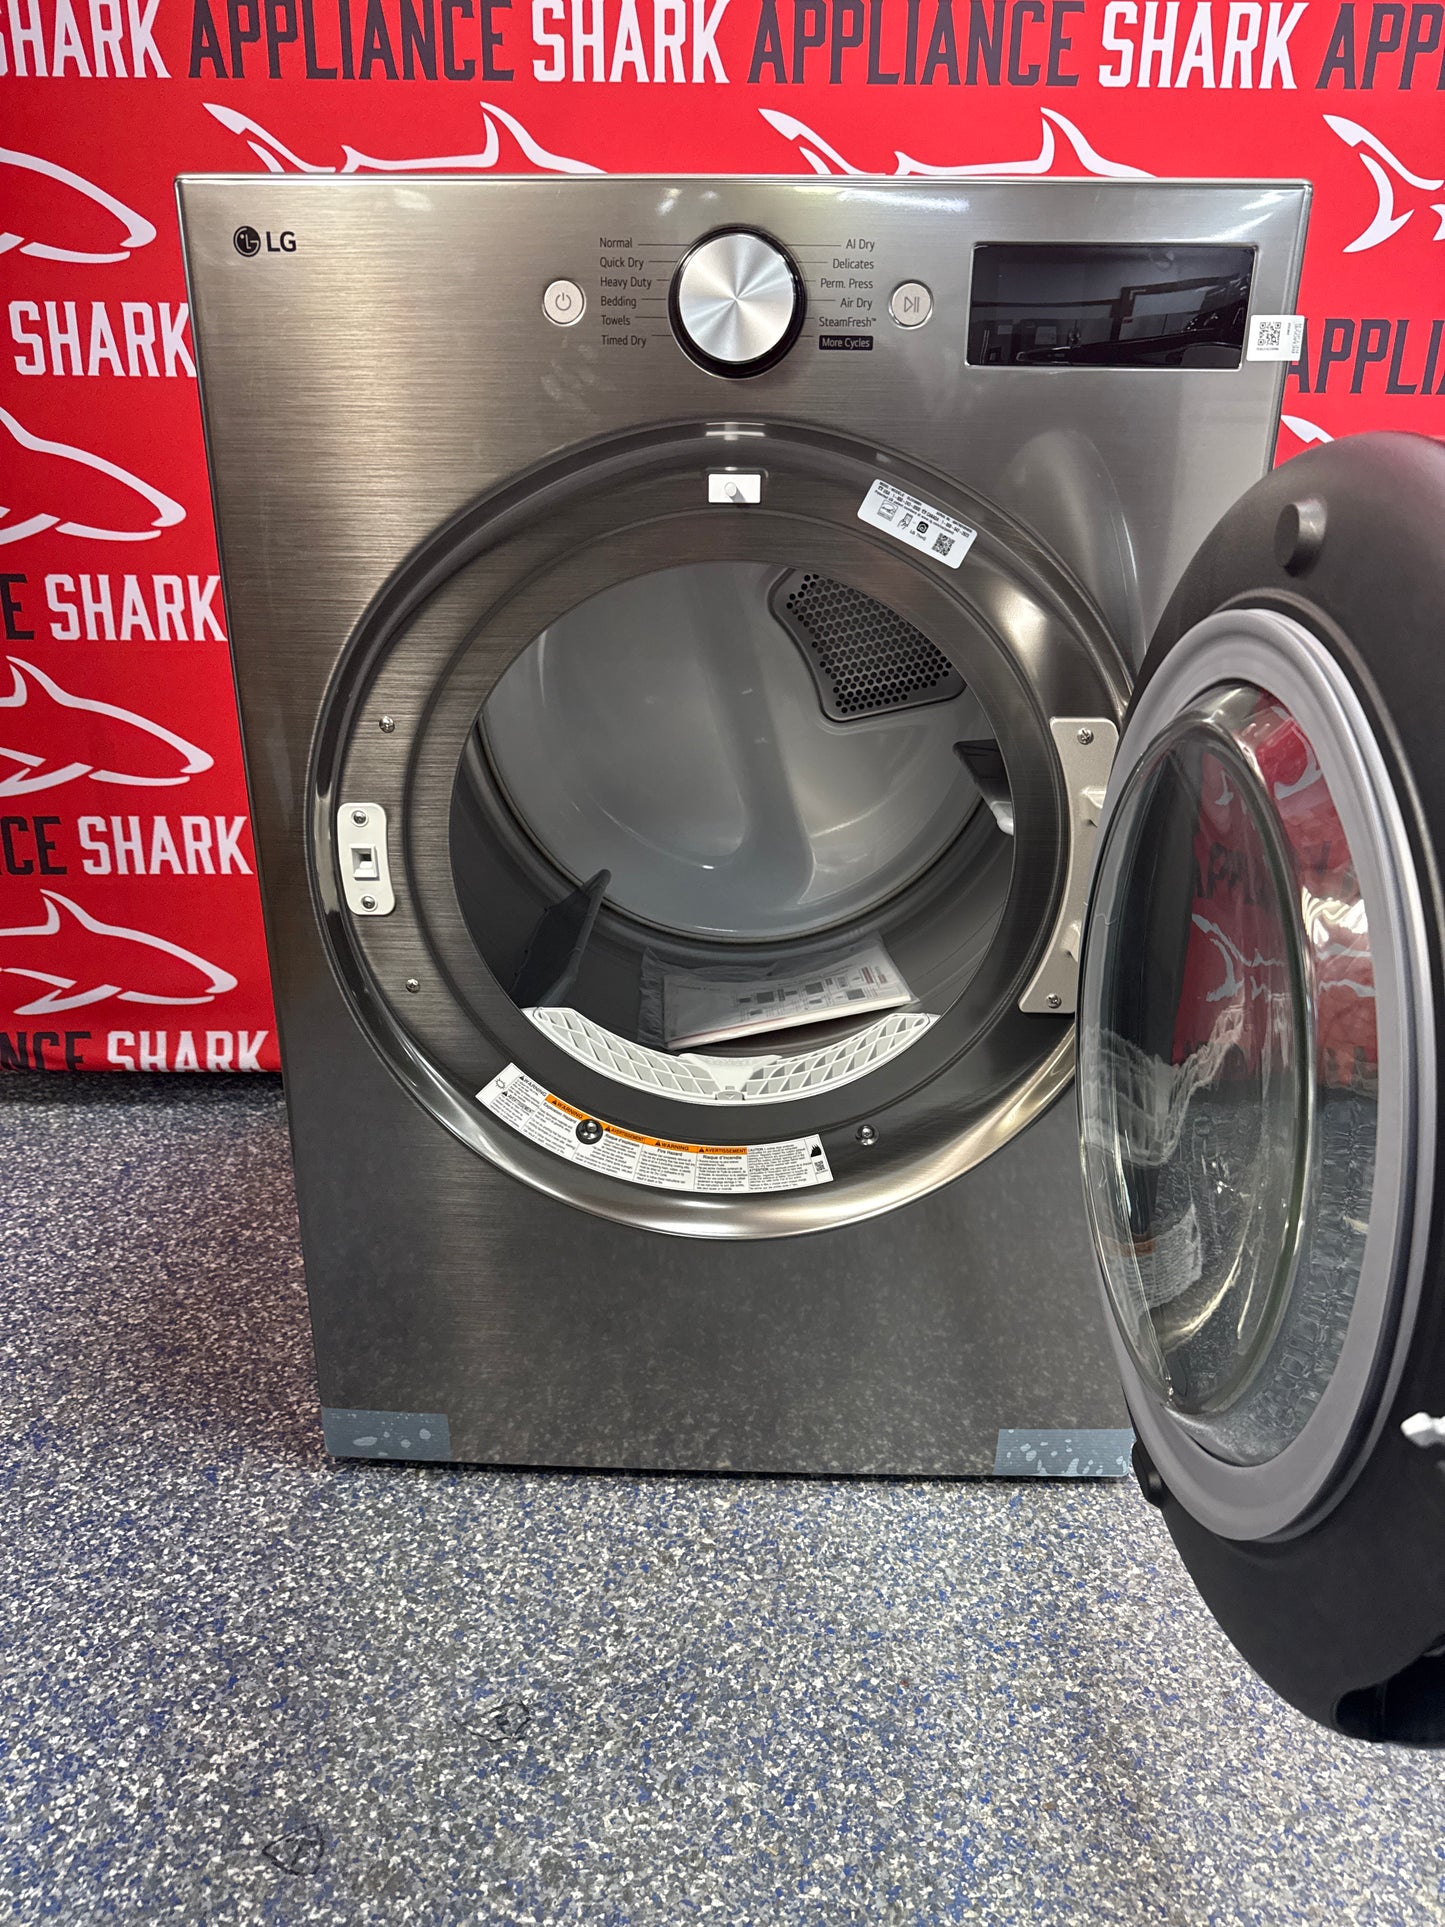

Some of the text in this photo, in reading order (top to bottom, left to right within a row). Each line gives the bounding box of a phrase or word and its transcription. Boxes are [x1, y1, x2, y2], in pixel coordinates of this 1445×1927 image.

[0, 0, 1445, 90] HARK APPLIANCE SHARK APPLIANCE SHARK APP
[266, 230, 297, 252] LG
[599, 237, 633, 249] Normal
[845, 239, 875, 252] AI Dry
[599, 256, 645, 270] Quick Dry
[832, 258, 875, 269] Delicates
[600, 276, 652, 290] Heavy Duty
[820, 278, 874, 289] Perm. Press
[600, 295, 637, 309] Bedding
[840, 298, 873, 311] Air Dry
[601, 314, 631, 326] Towels
[8, 301, 197, 377] SHARK
[601, 334, 647, 348] Timed Dry
[822, 337, 870, 349] More Cycles
[1288, 318, 1445, 395] APPLI
[44, 574, 228, 641] SHARK
[77, 816, 254, 875] SHARK
[107, 1031, 269, 1072] SHARK
[557, 1101, 584, 1119] WARNING
[661, 1142, 689, 1151] WARNING
